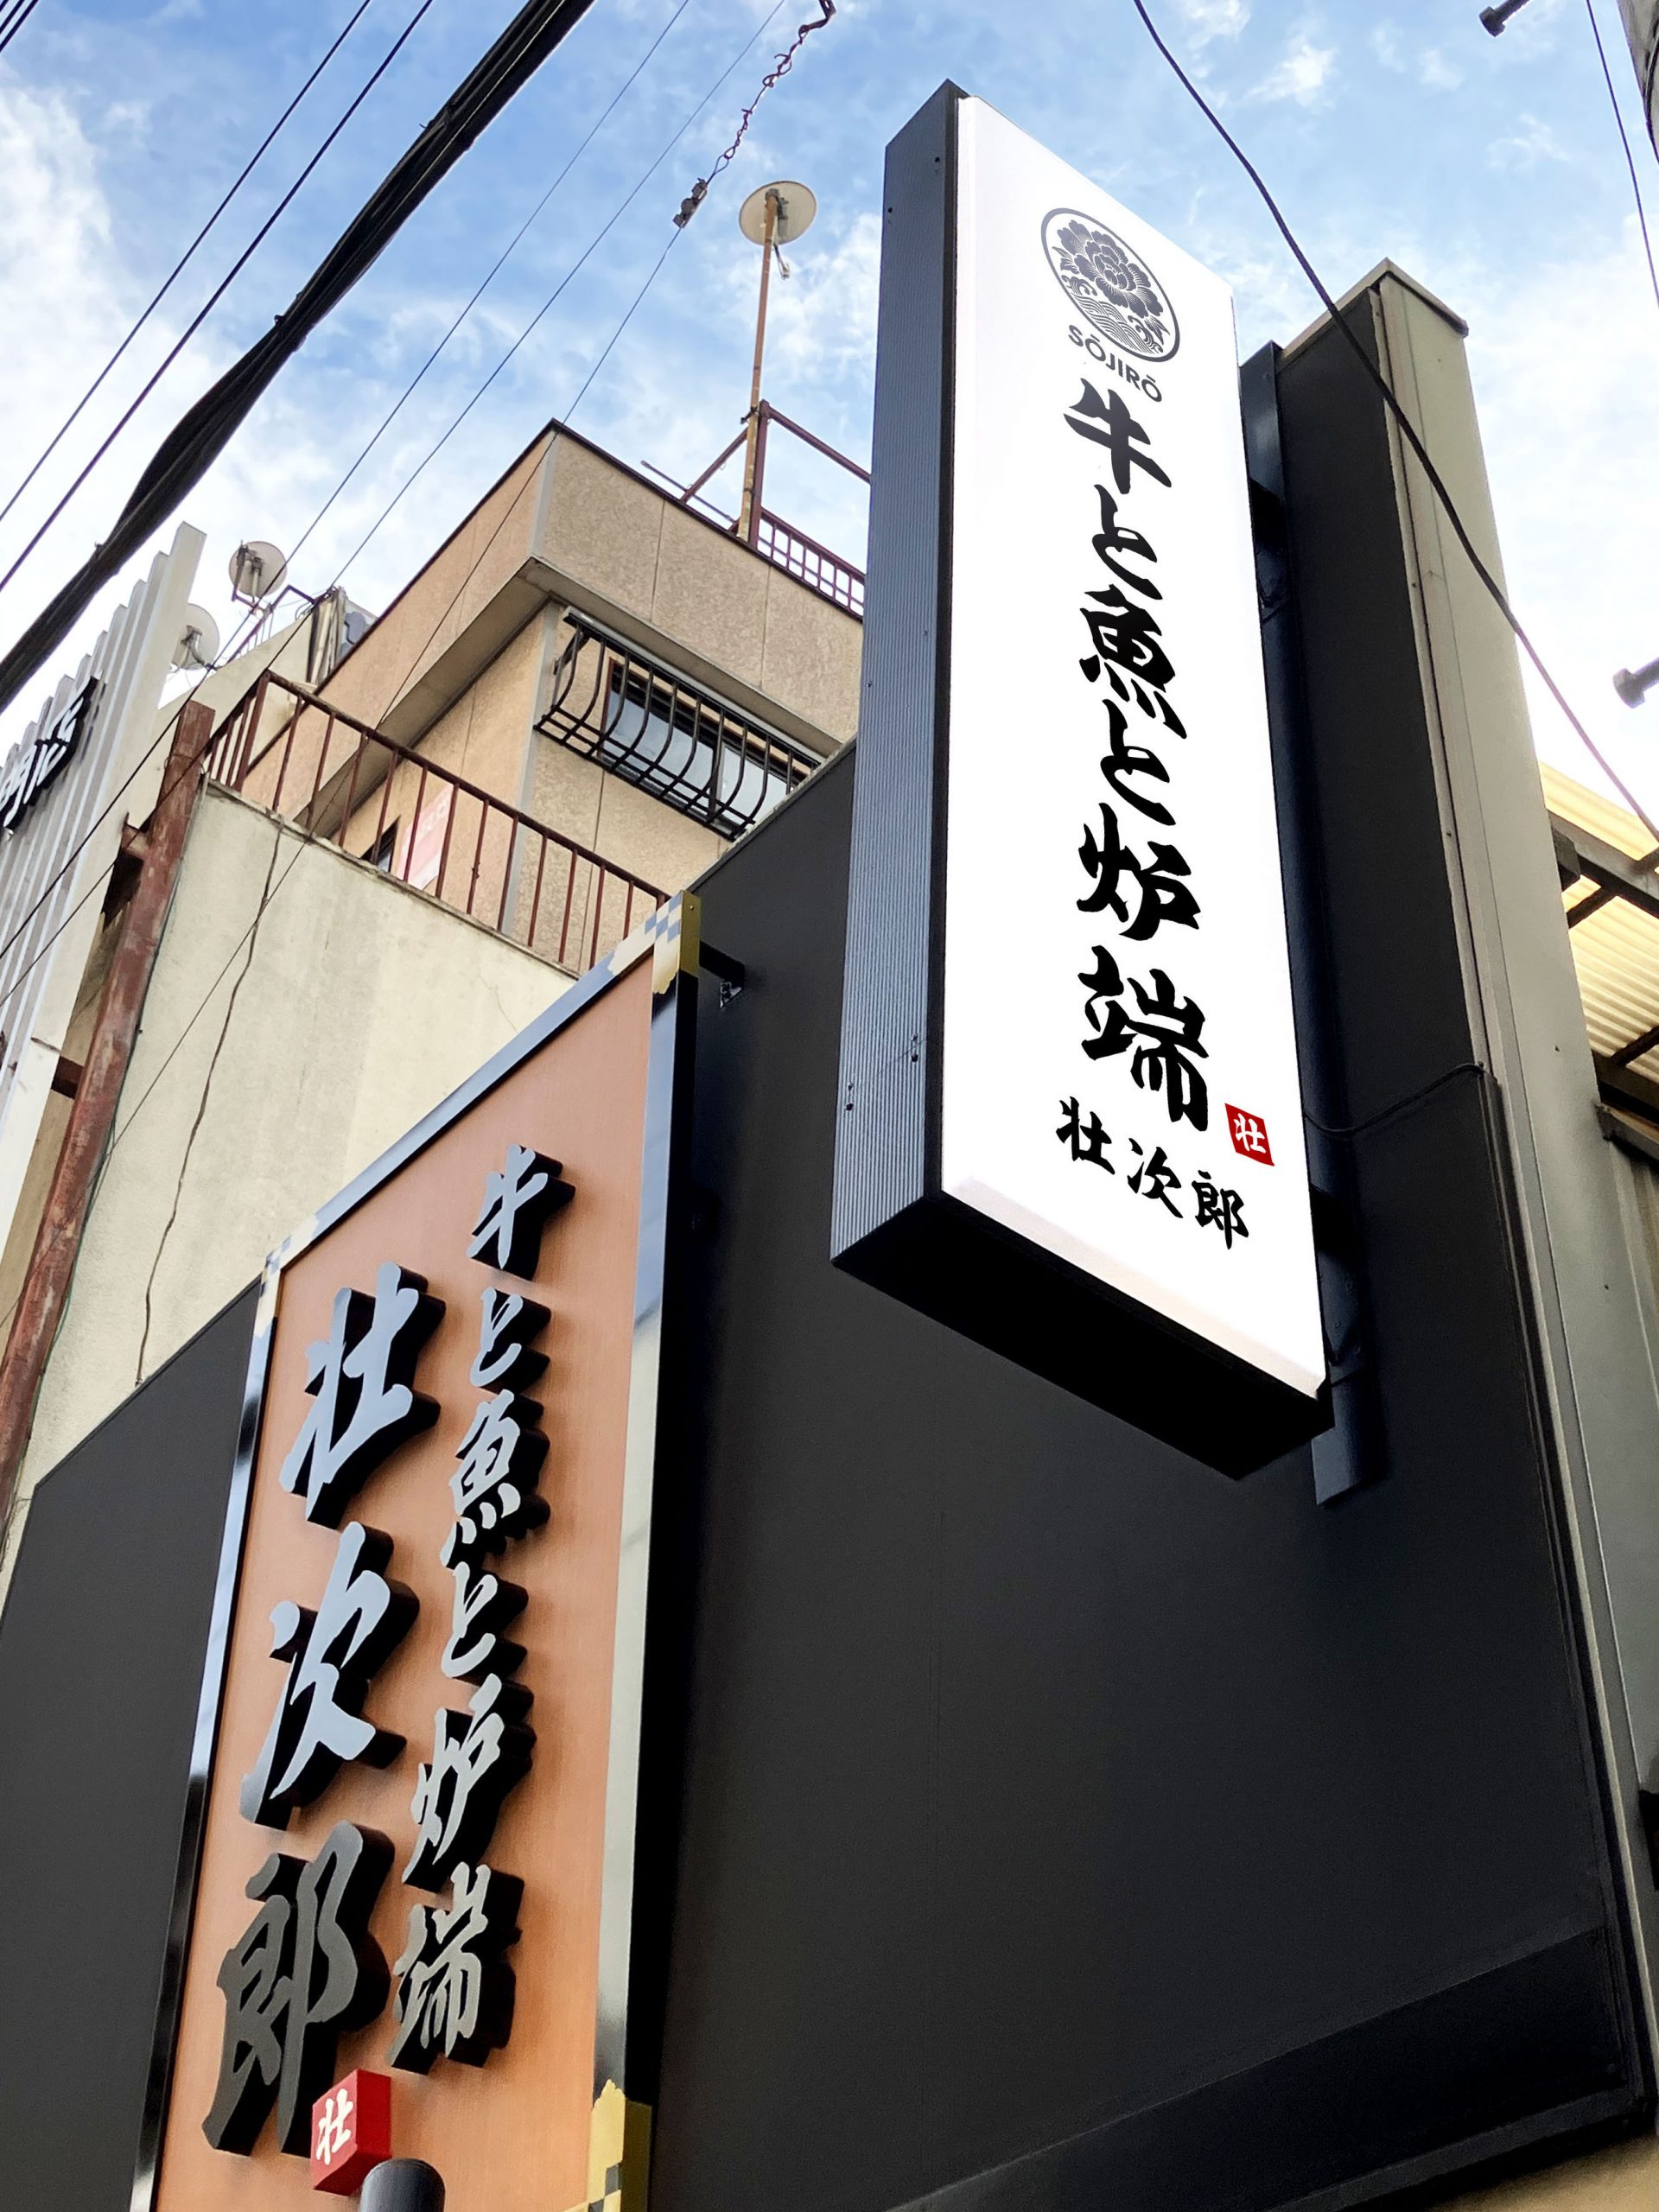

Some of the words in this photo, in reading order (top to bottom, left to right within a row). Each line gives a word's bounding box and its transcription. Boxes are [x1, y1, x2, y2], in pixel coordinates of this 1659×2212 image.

[1068, 324, 1163, 404] SŌJIRŌ
[1063, 378, 1210, 1132] 牛と魚と炉端
[1055, 1096, 1249, 1250] 壮次郎
[1234, 1112, 1268, 1155] 壮
[388, 1143, 557, 2068] 牛と魚と炉端
[201, 1261, 428, 2152] 壮次郎
[315, 2088, 355, 2165] 壮
